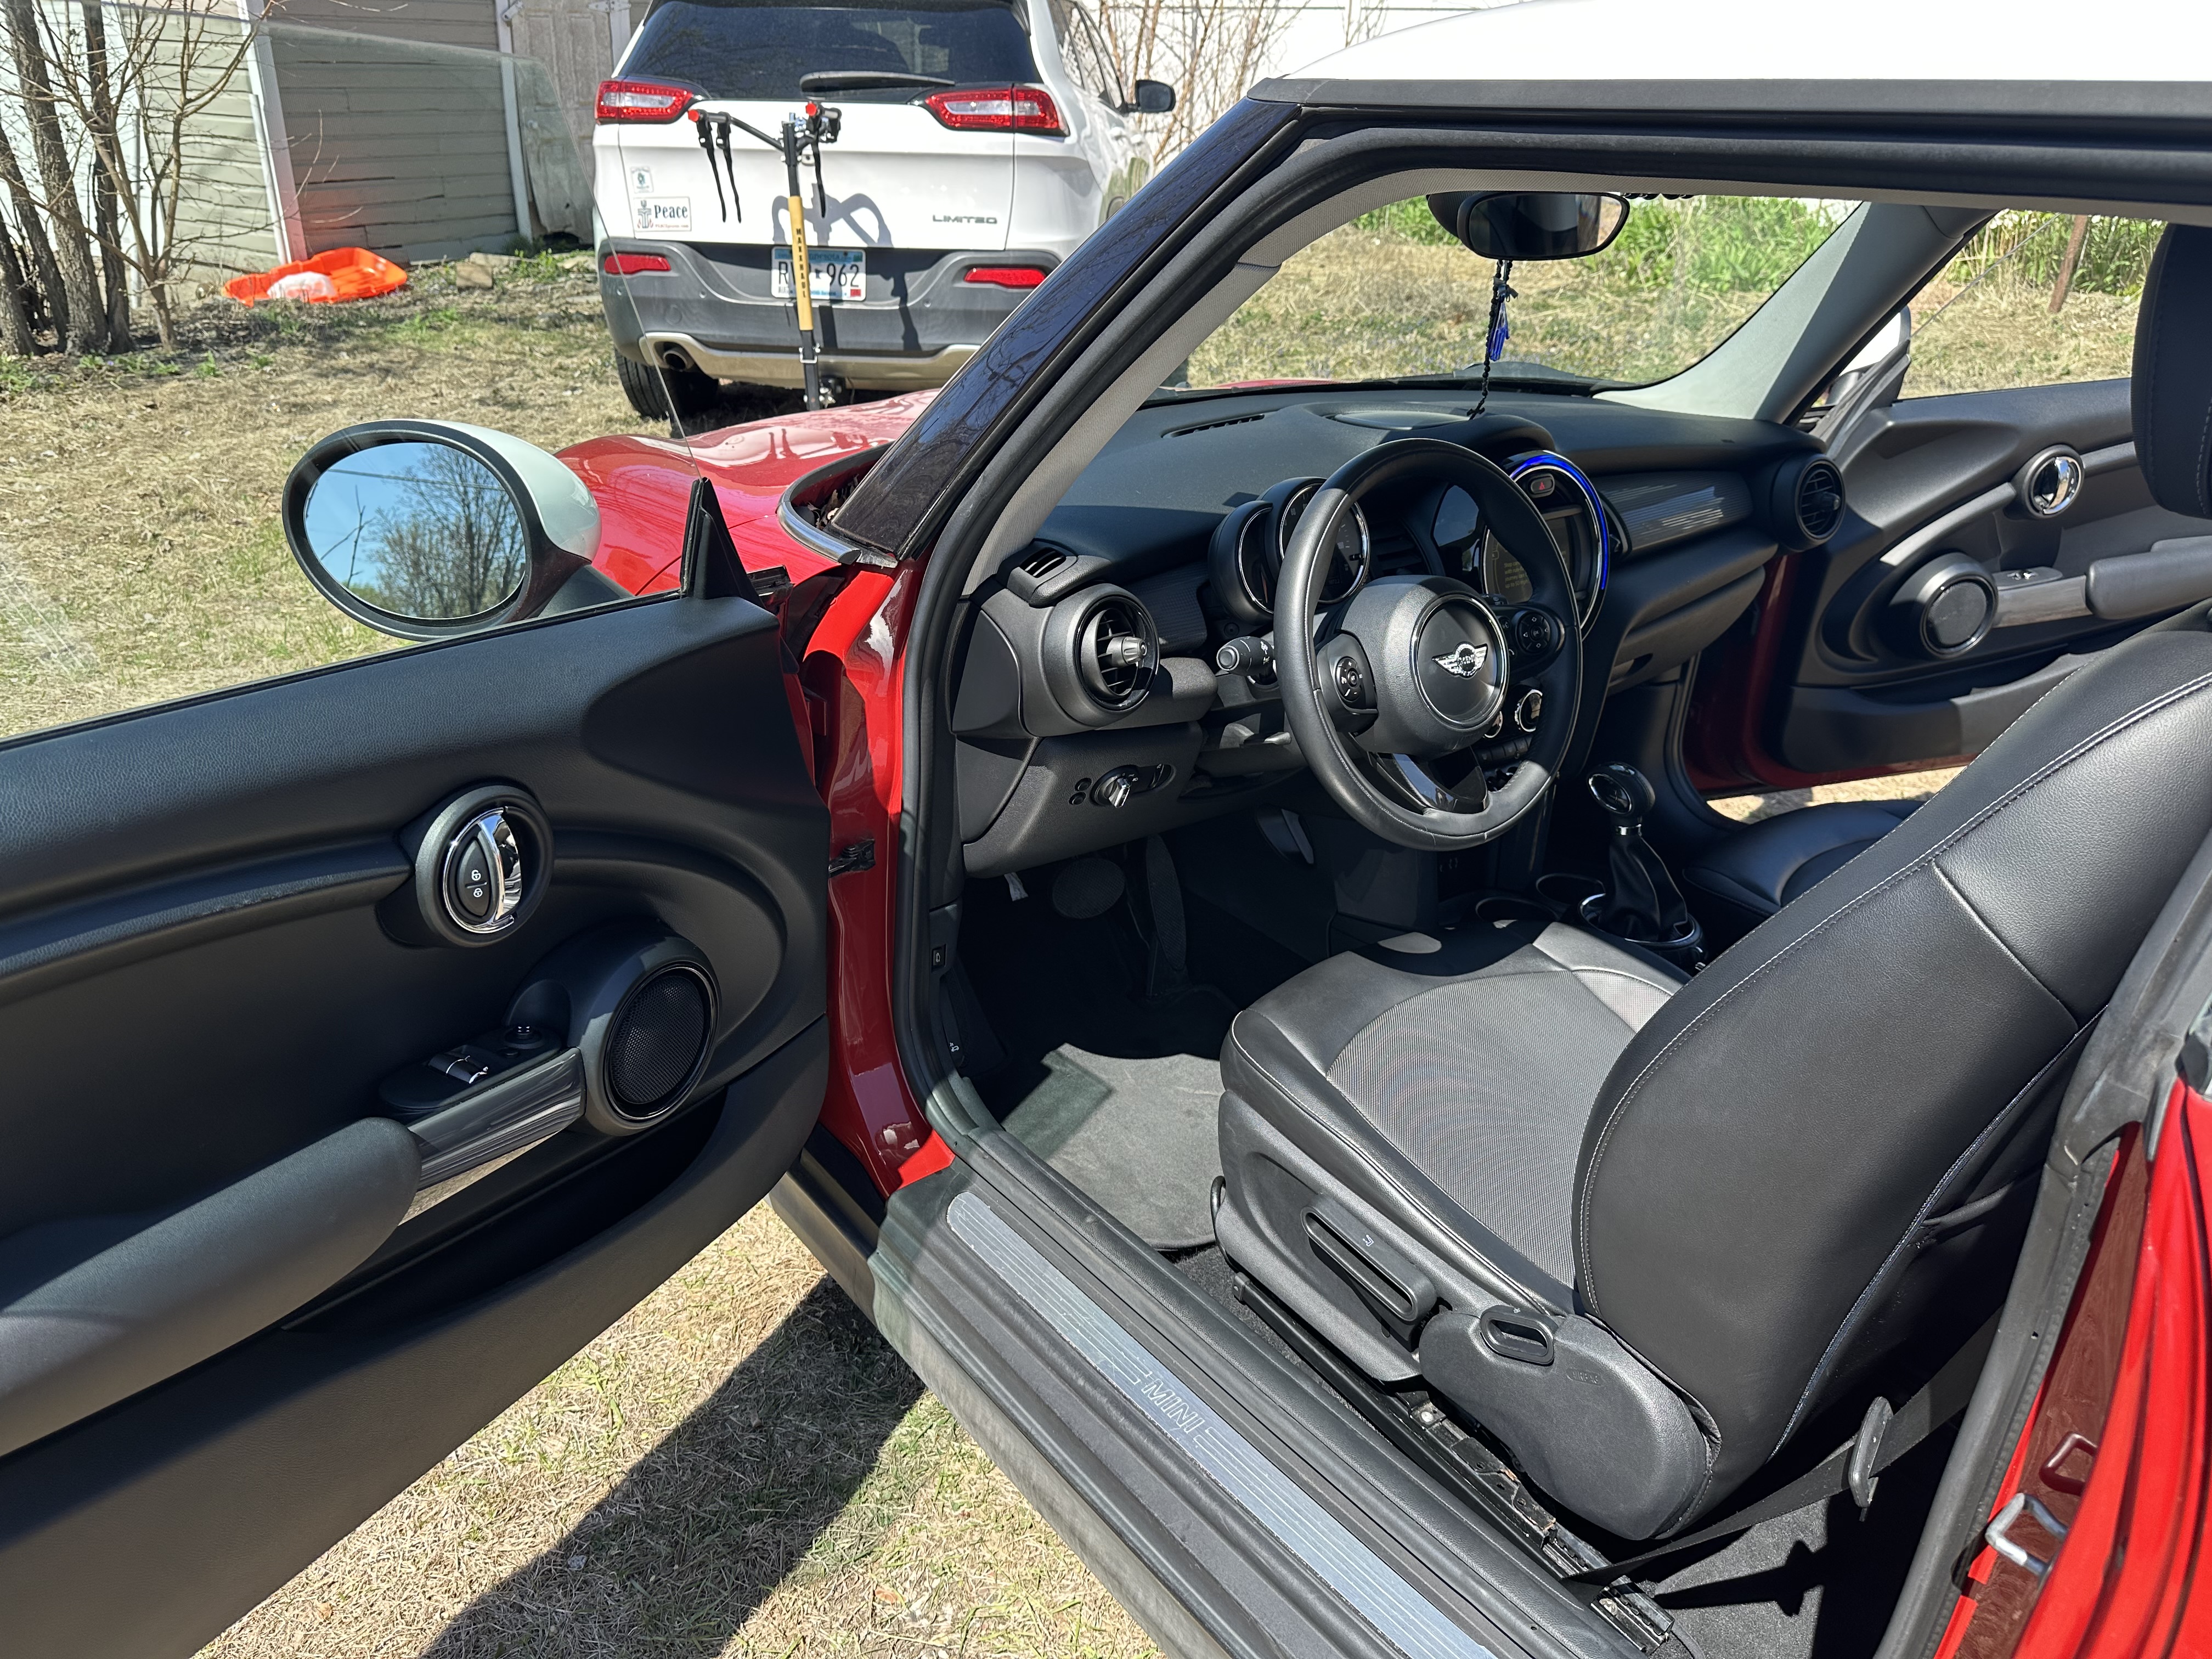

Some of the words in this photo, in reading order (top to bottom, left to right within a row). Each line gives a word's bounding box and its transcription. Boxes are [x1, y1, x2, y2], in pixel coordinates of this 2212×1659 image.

[654, 205, 689, 219] Peace
[933, 215, 997, 224] LIMITED
[827, 263, 860, 287] 962
[1141, 1378, 1205, 1435] MINI
